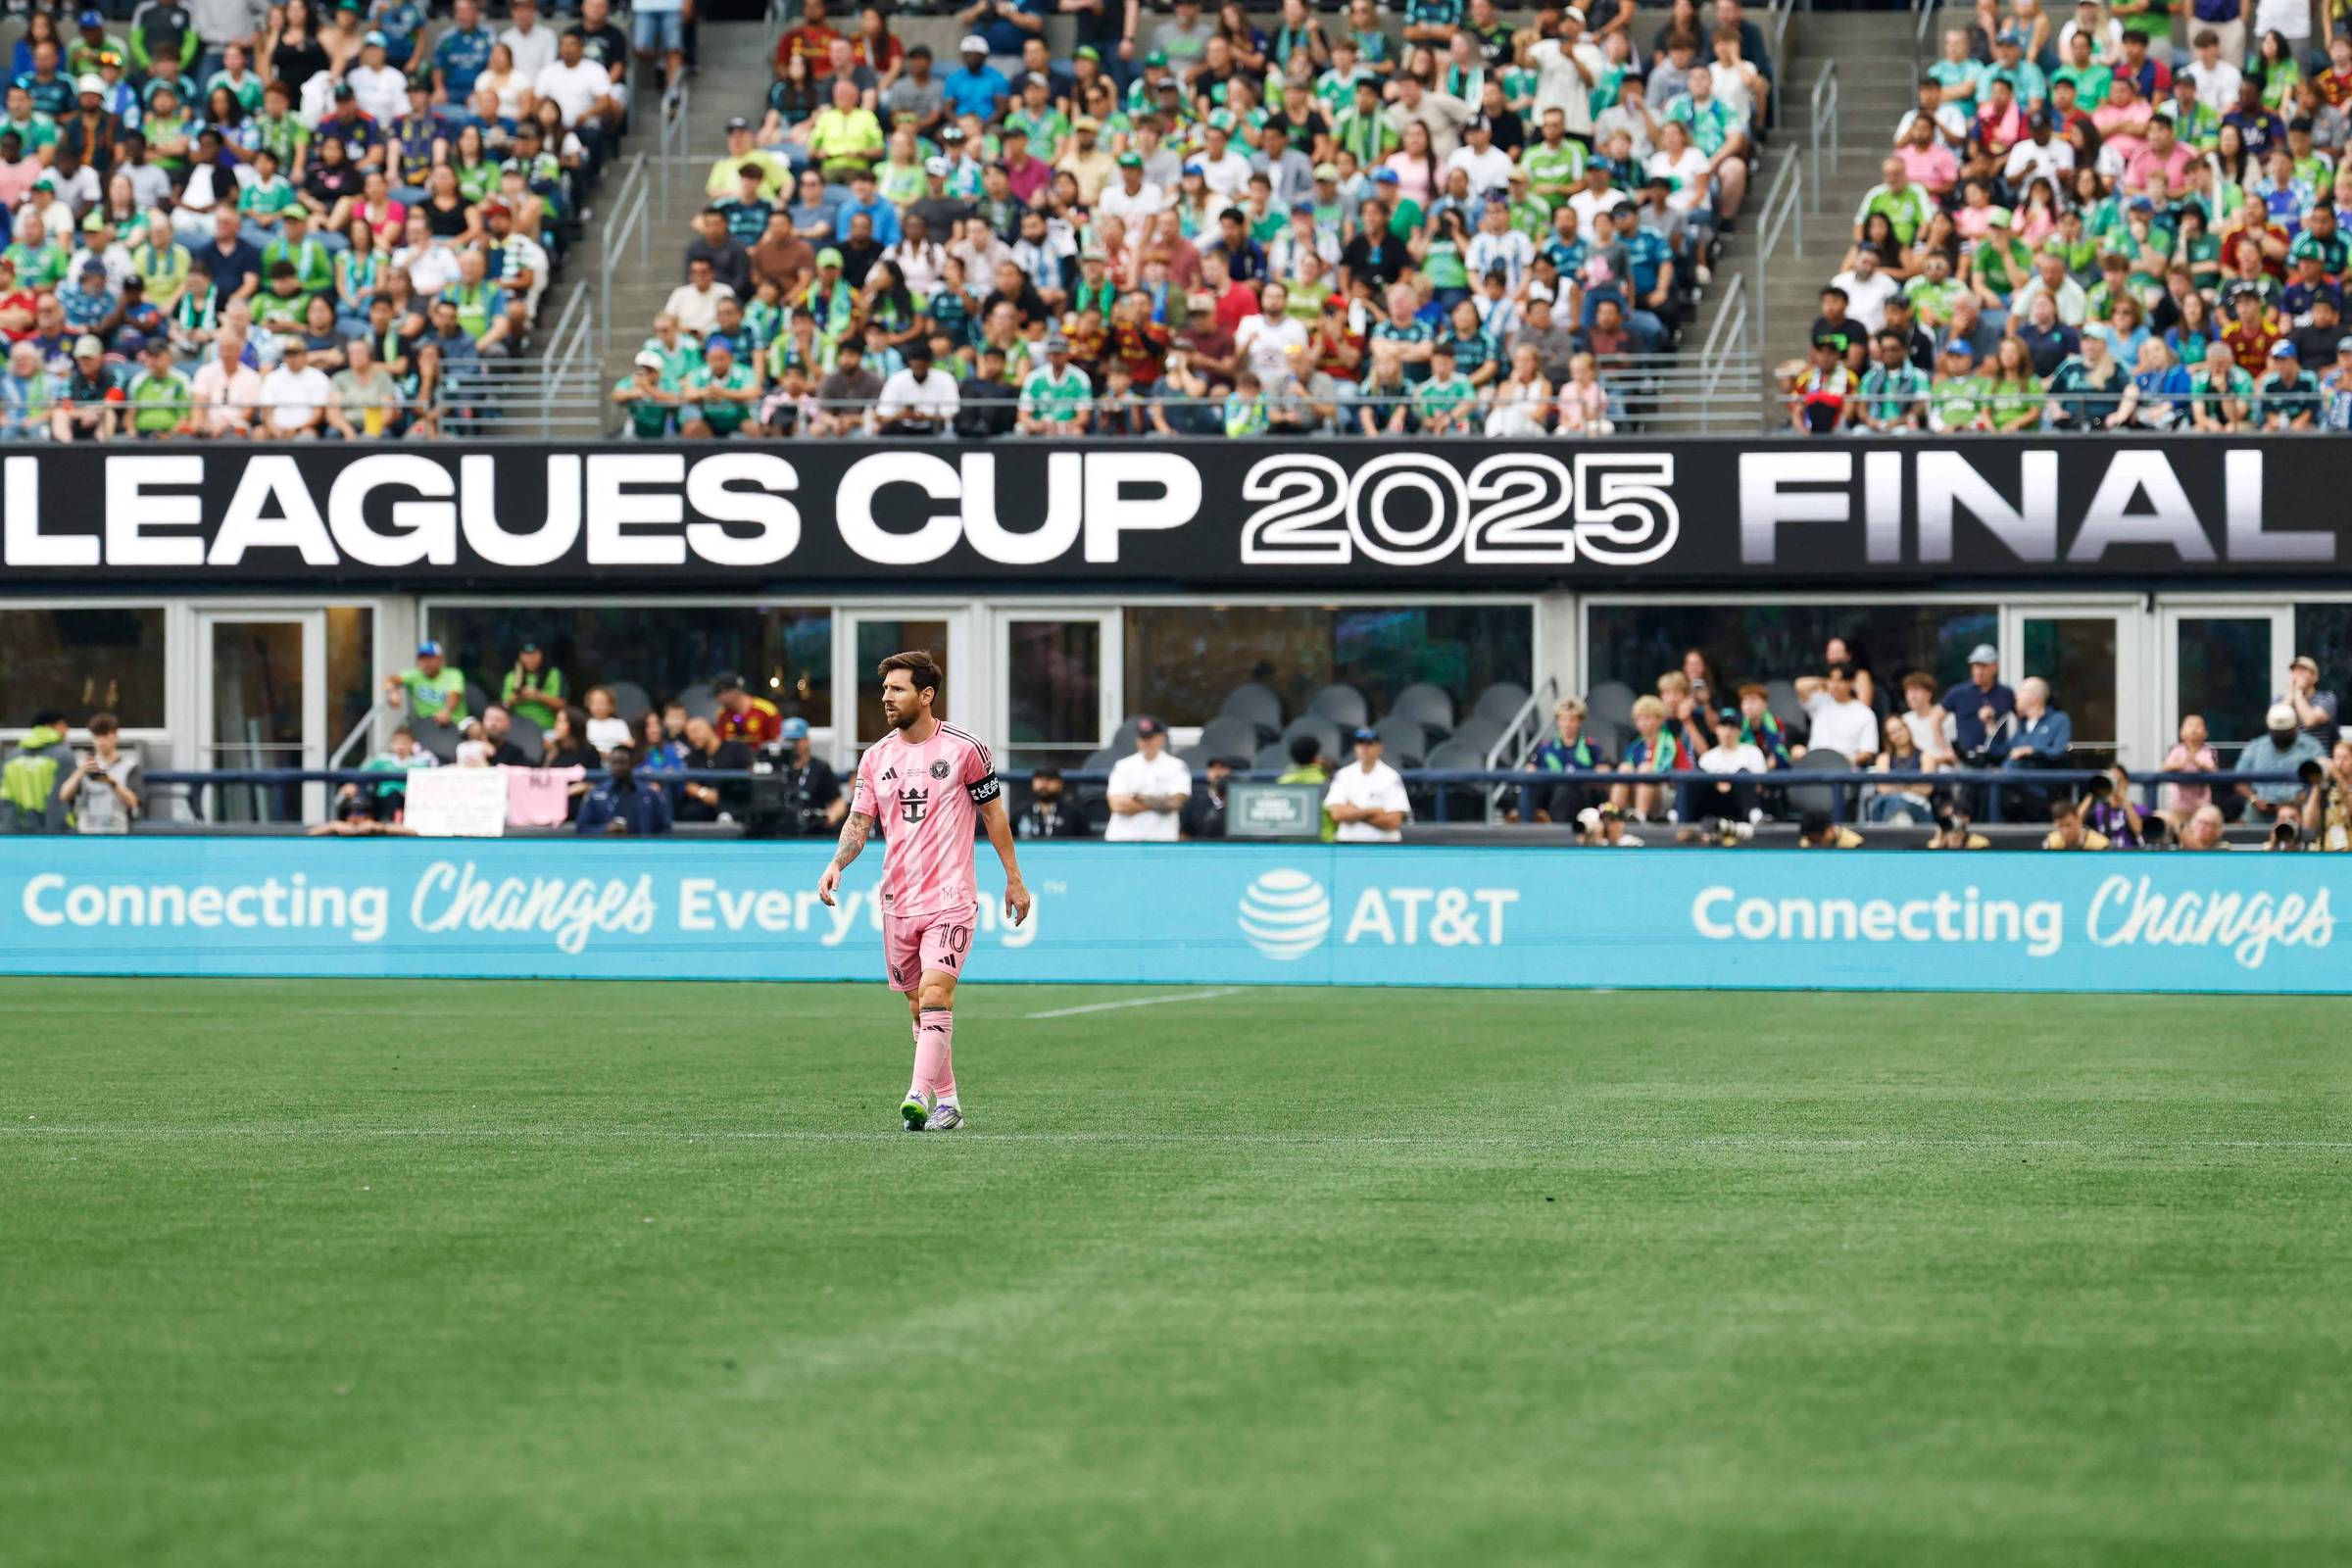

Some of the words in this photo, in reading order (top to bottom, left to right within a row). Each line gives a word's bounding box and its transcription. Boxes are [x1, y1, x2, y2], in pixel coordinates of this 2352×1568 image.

[4, 452, 802, 567] LEAGUES
[836, 451, 1202, 565] CUP
[1240, 452, 1680, 566] 2025
[1738, 449, 2335, 564] FINAL
[23, 872, 389, 943] Connecting
[410, 861, 658, 955] Changes
[939, 922, 968, 954] 10
[1344, 886, 1521, 947] AT&T
[1690, 886, 2063, 957] Connecting
[2085, 875, 2335, 969] Changes
